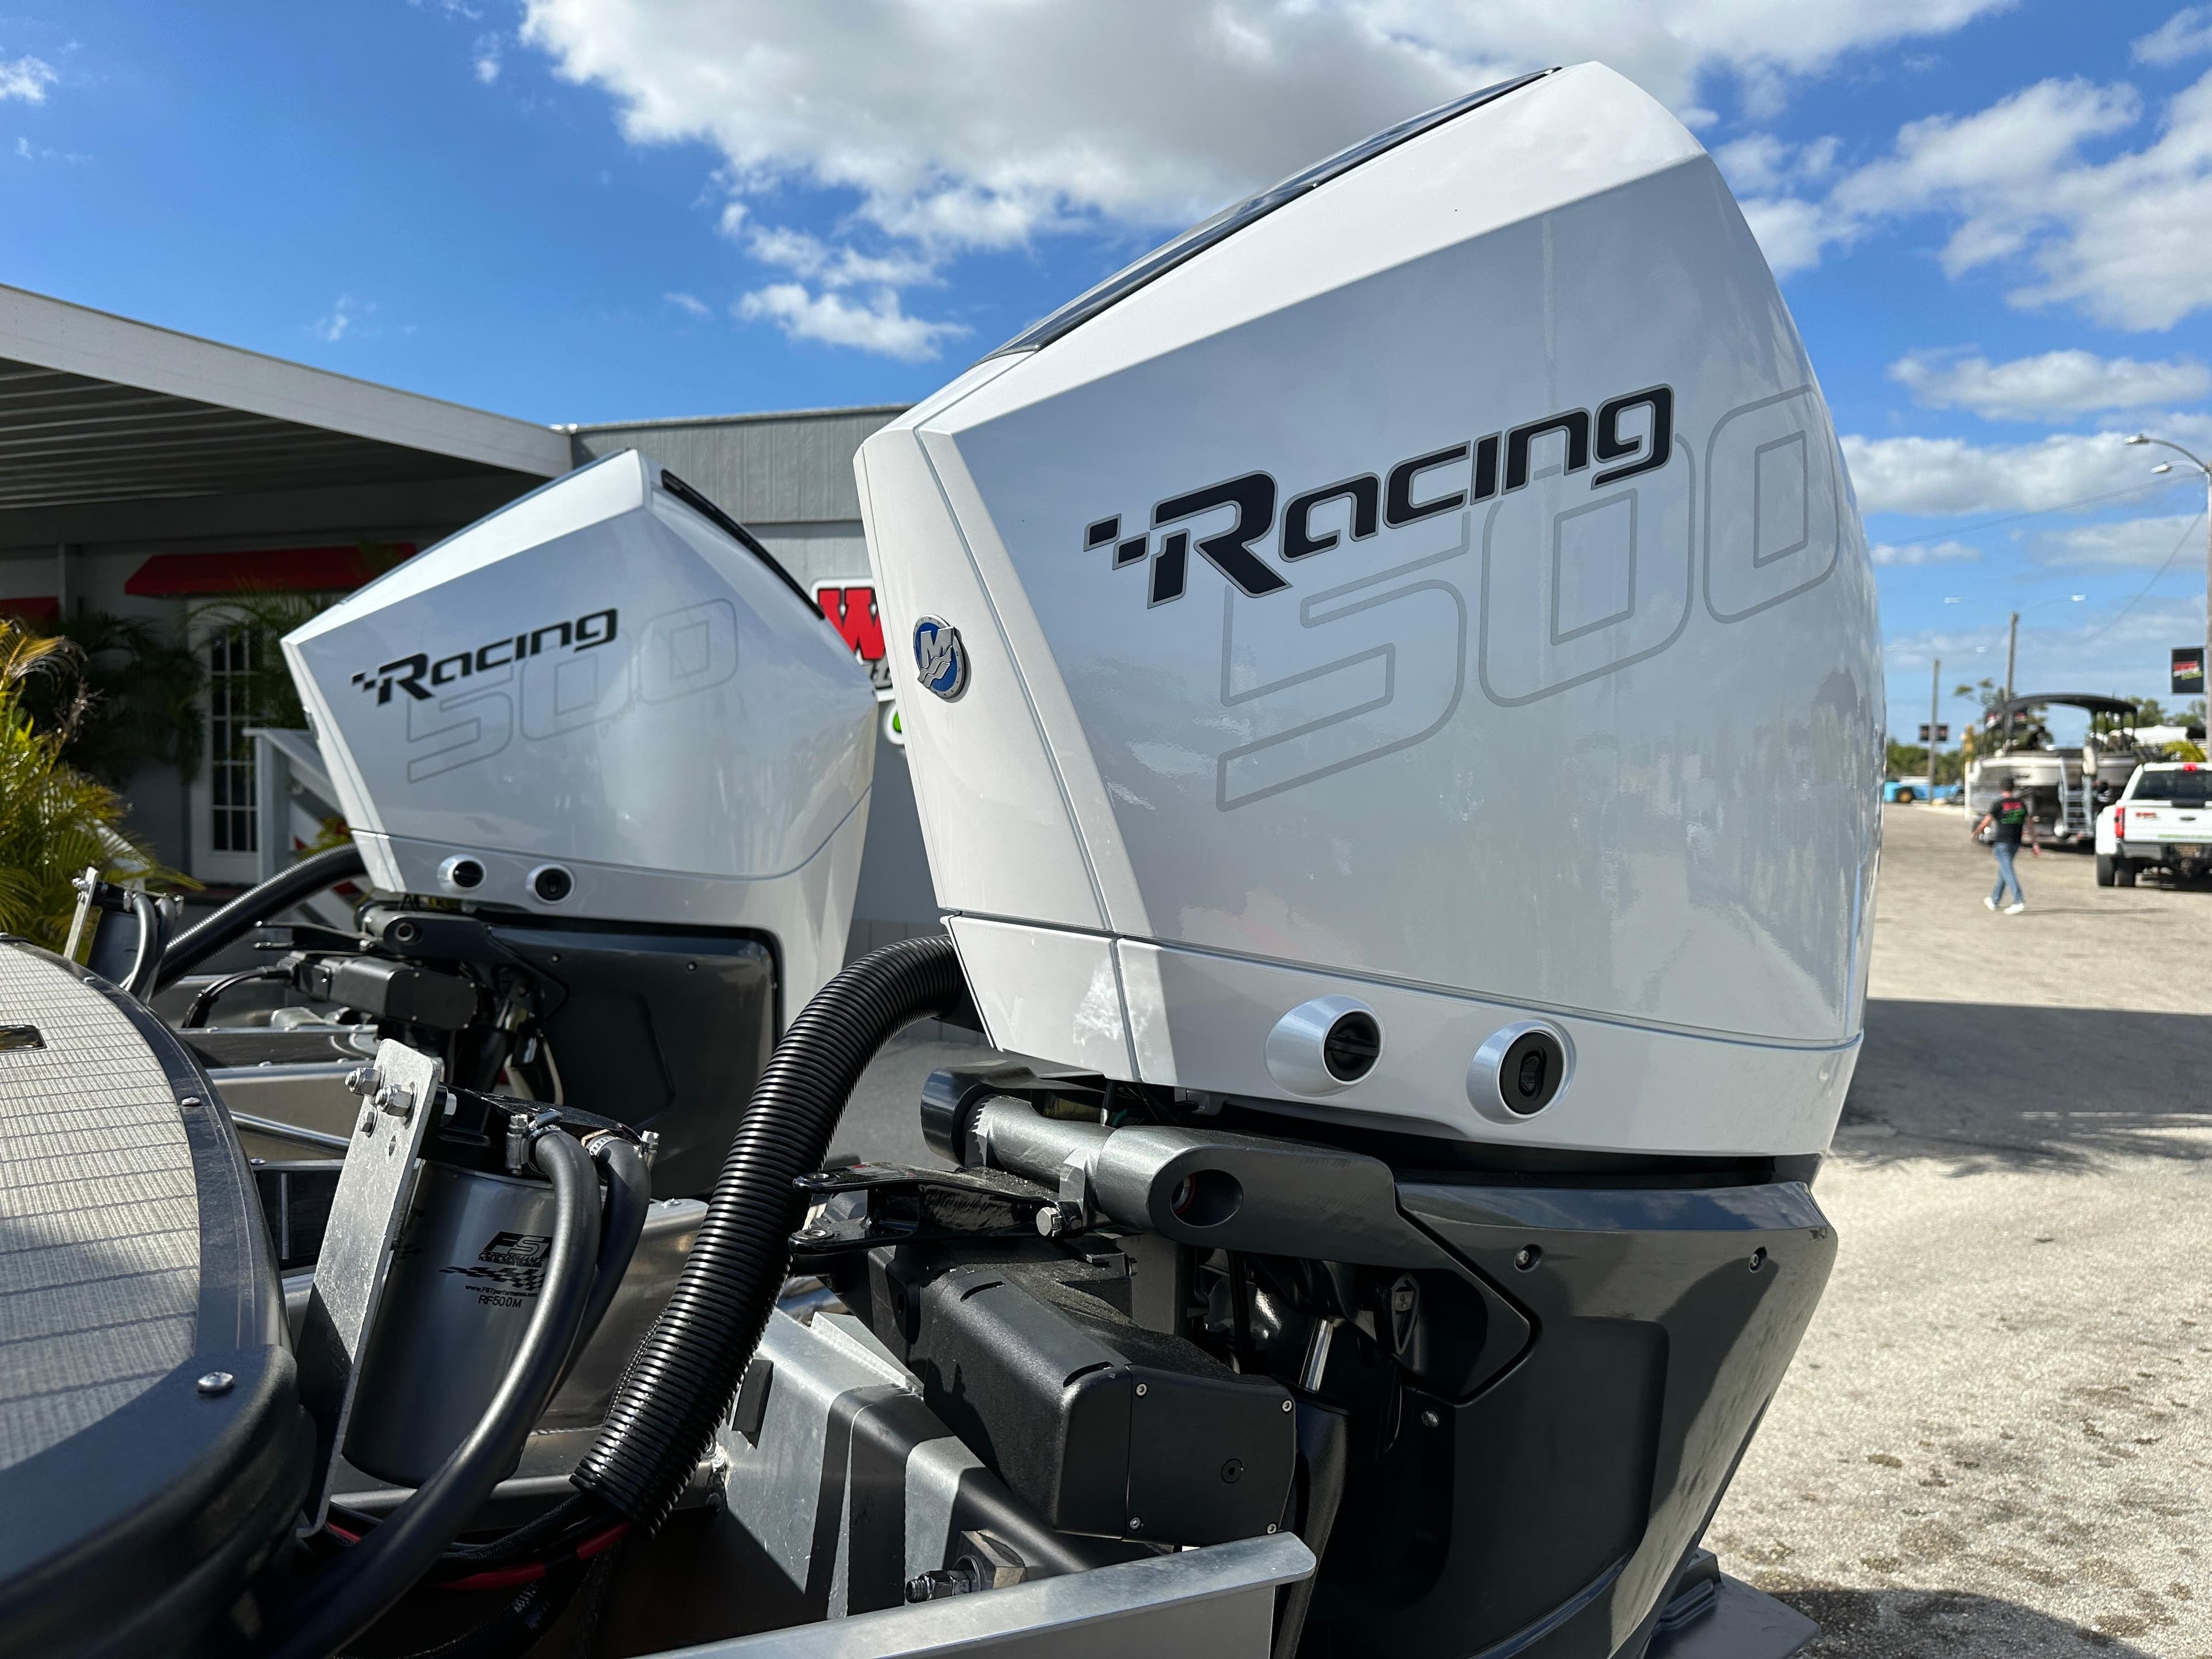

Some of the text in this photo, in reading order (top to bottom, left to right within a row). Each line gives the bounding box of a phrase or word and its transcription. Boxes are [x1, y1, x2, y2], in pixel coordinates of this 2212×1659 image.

[1146, 384, 1673, 609] Racing
[376, 608, 618, 706] Racing
[407, 598, 738, 784] 500
[1217, 384, 1840, 813] 500
[478, 1295, 523, 1308] RF500M
